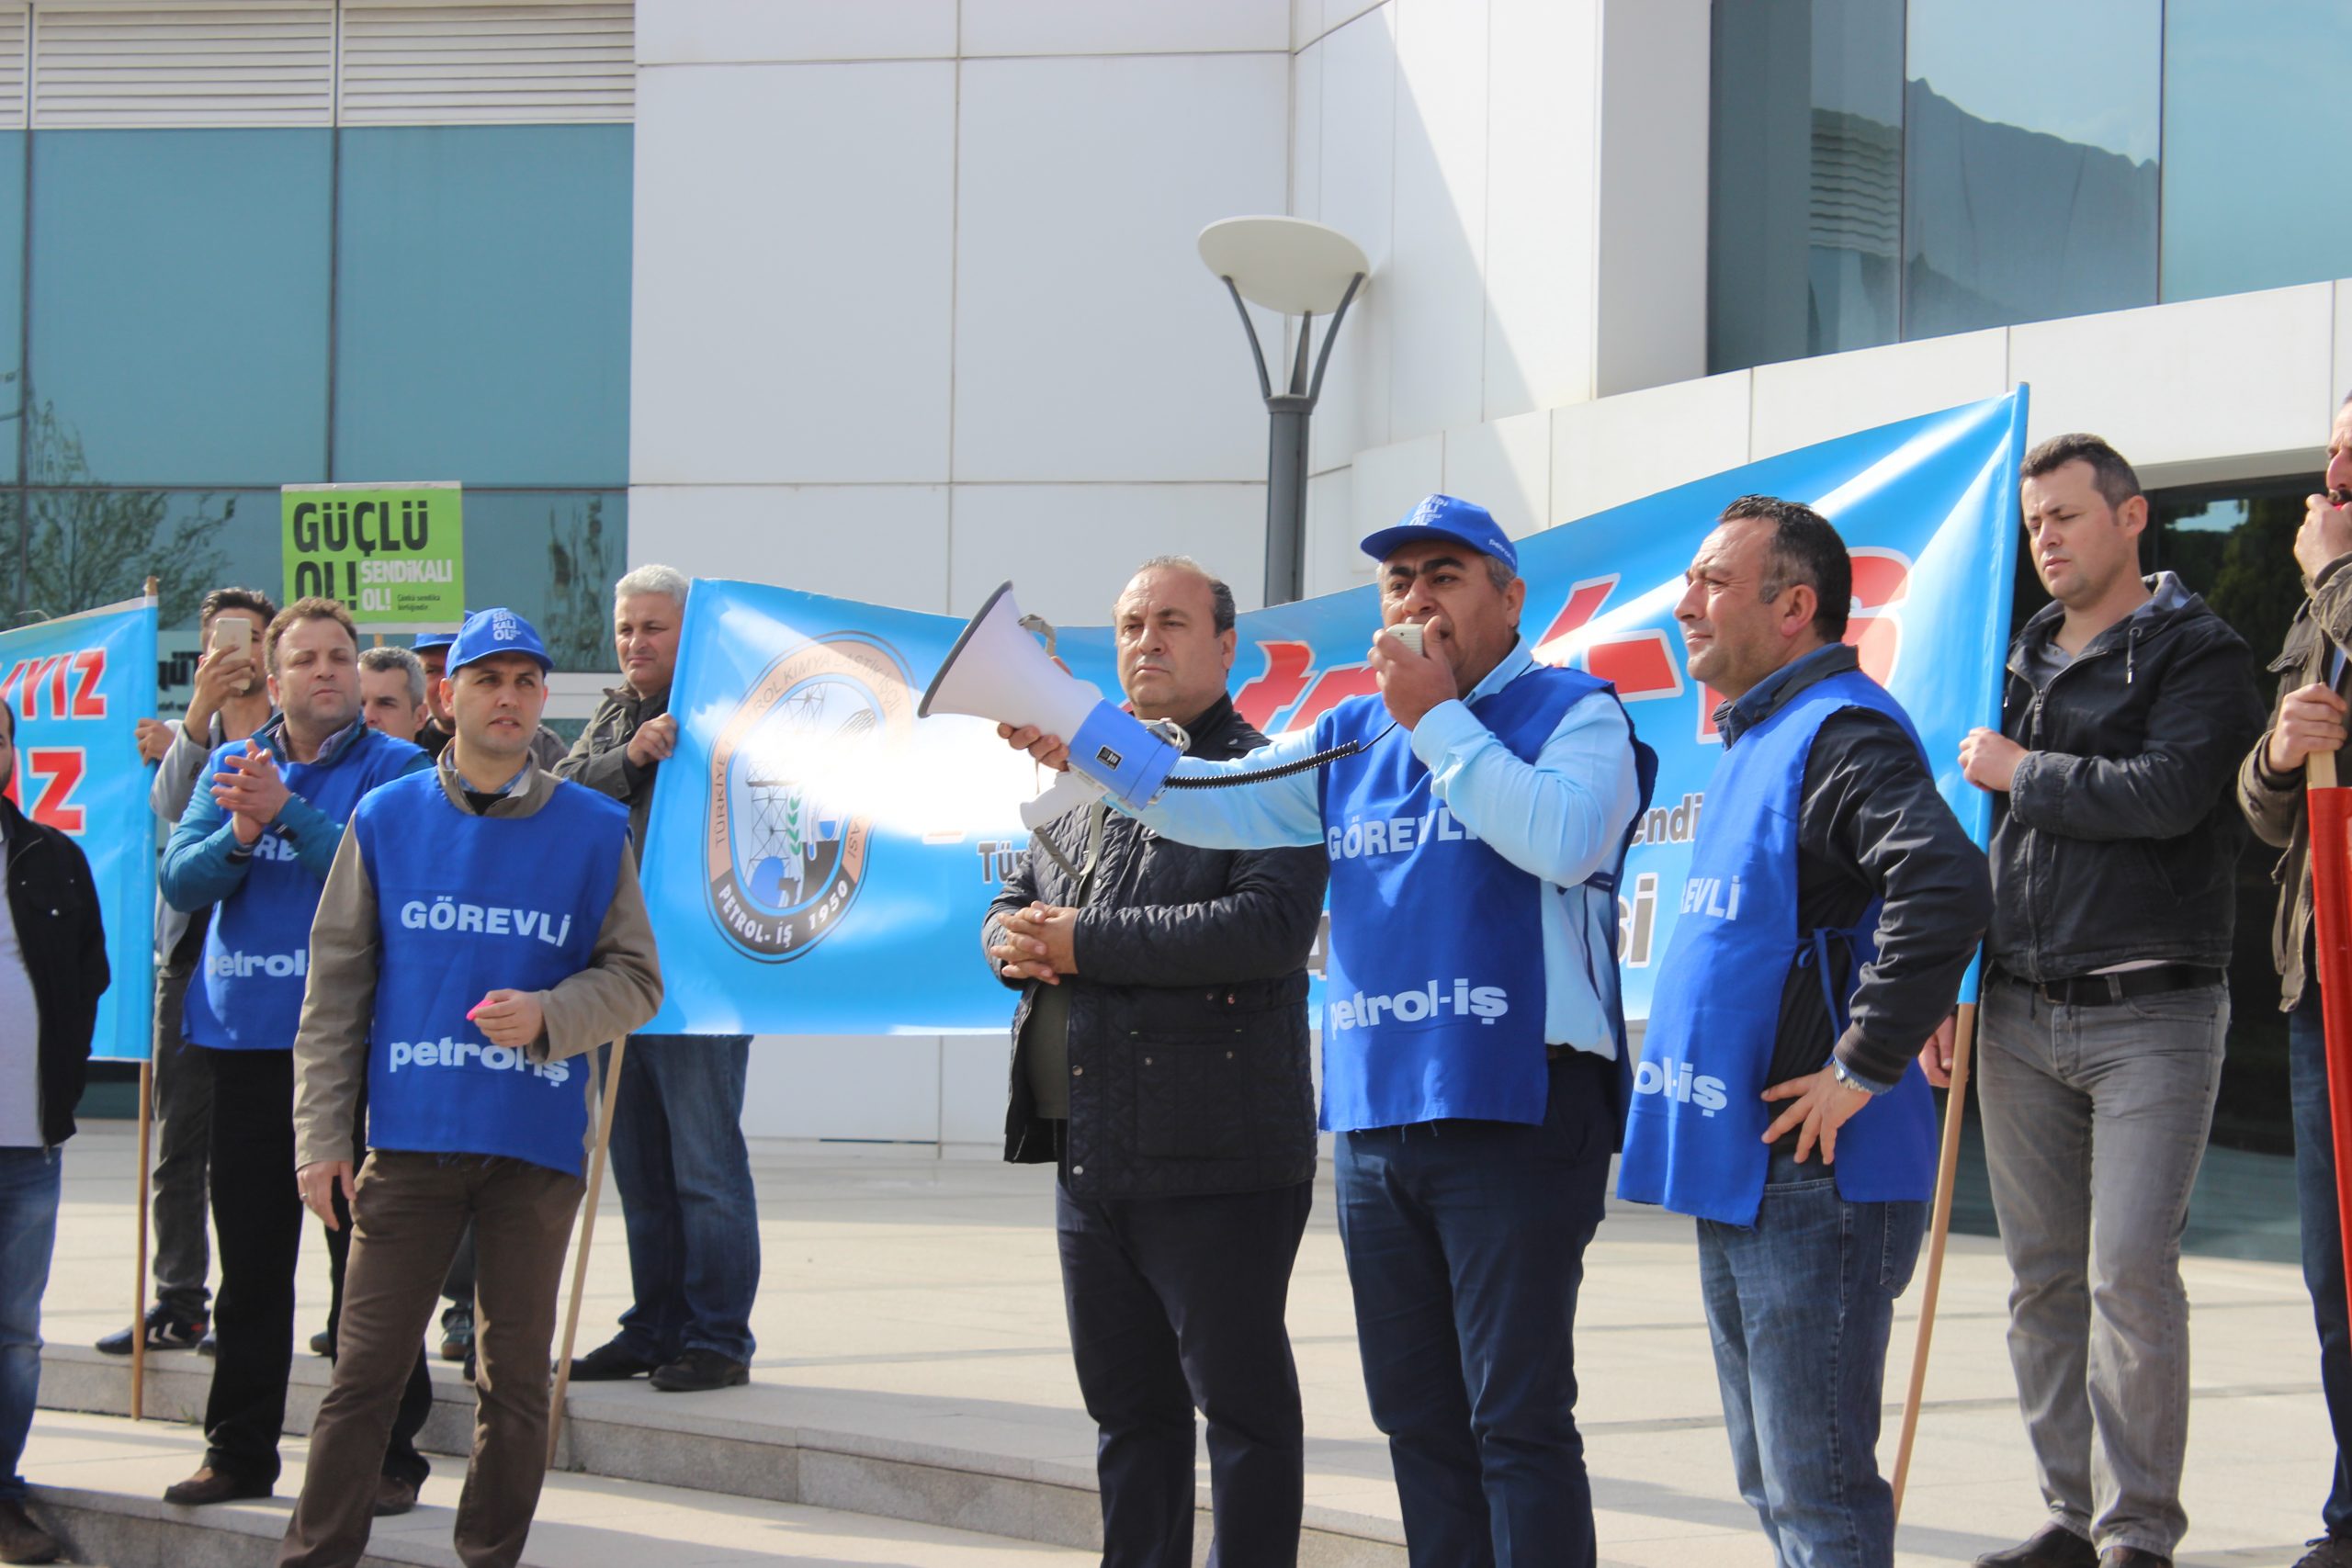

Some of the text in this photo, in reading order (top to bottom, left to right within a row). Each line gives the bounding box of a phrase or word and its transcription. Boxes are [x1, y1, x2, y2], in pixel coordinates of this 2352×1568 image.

[293, 501, 428, 557] GÜÇLÜ
[295, 561, 356, 611] OL!
[360, 559, 453, 583] SENDİKALI
[362, 588, 391, 611] OL!
[1327, 807, 1477, 862] GÖREVL
[401, 896, 571, 947] GÖREVLİ
[808, 880, 848, 931] 1950
[1679, 875, 1742, 921] EVLİ
[1330, 978, 1509, 1040] petrol-iş
